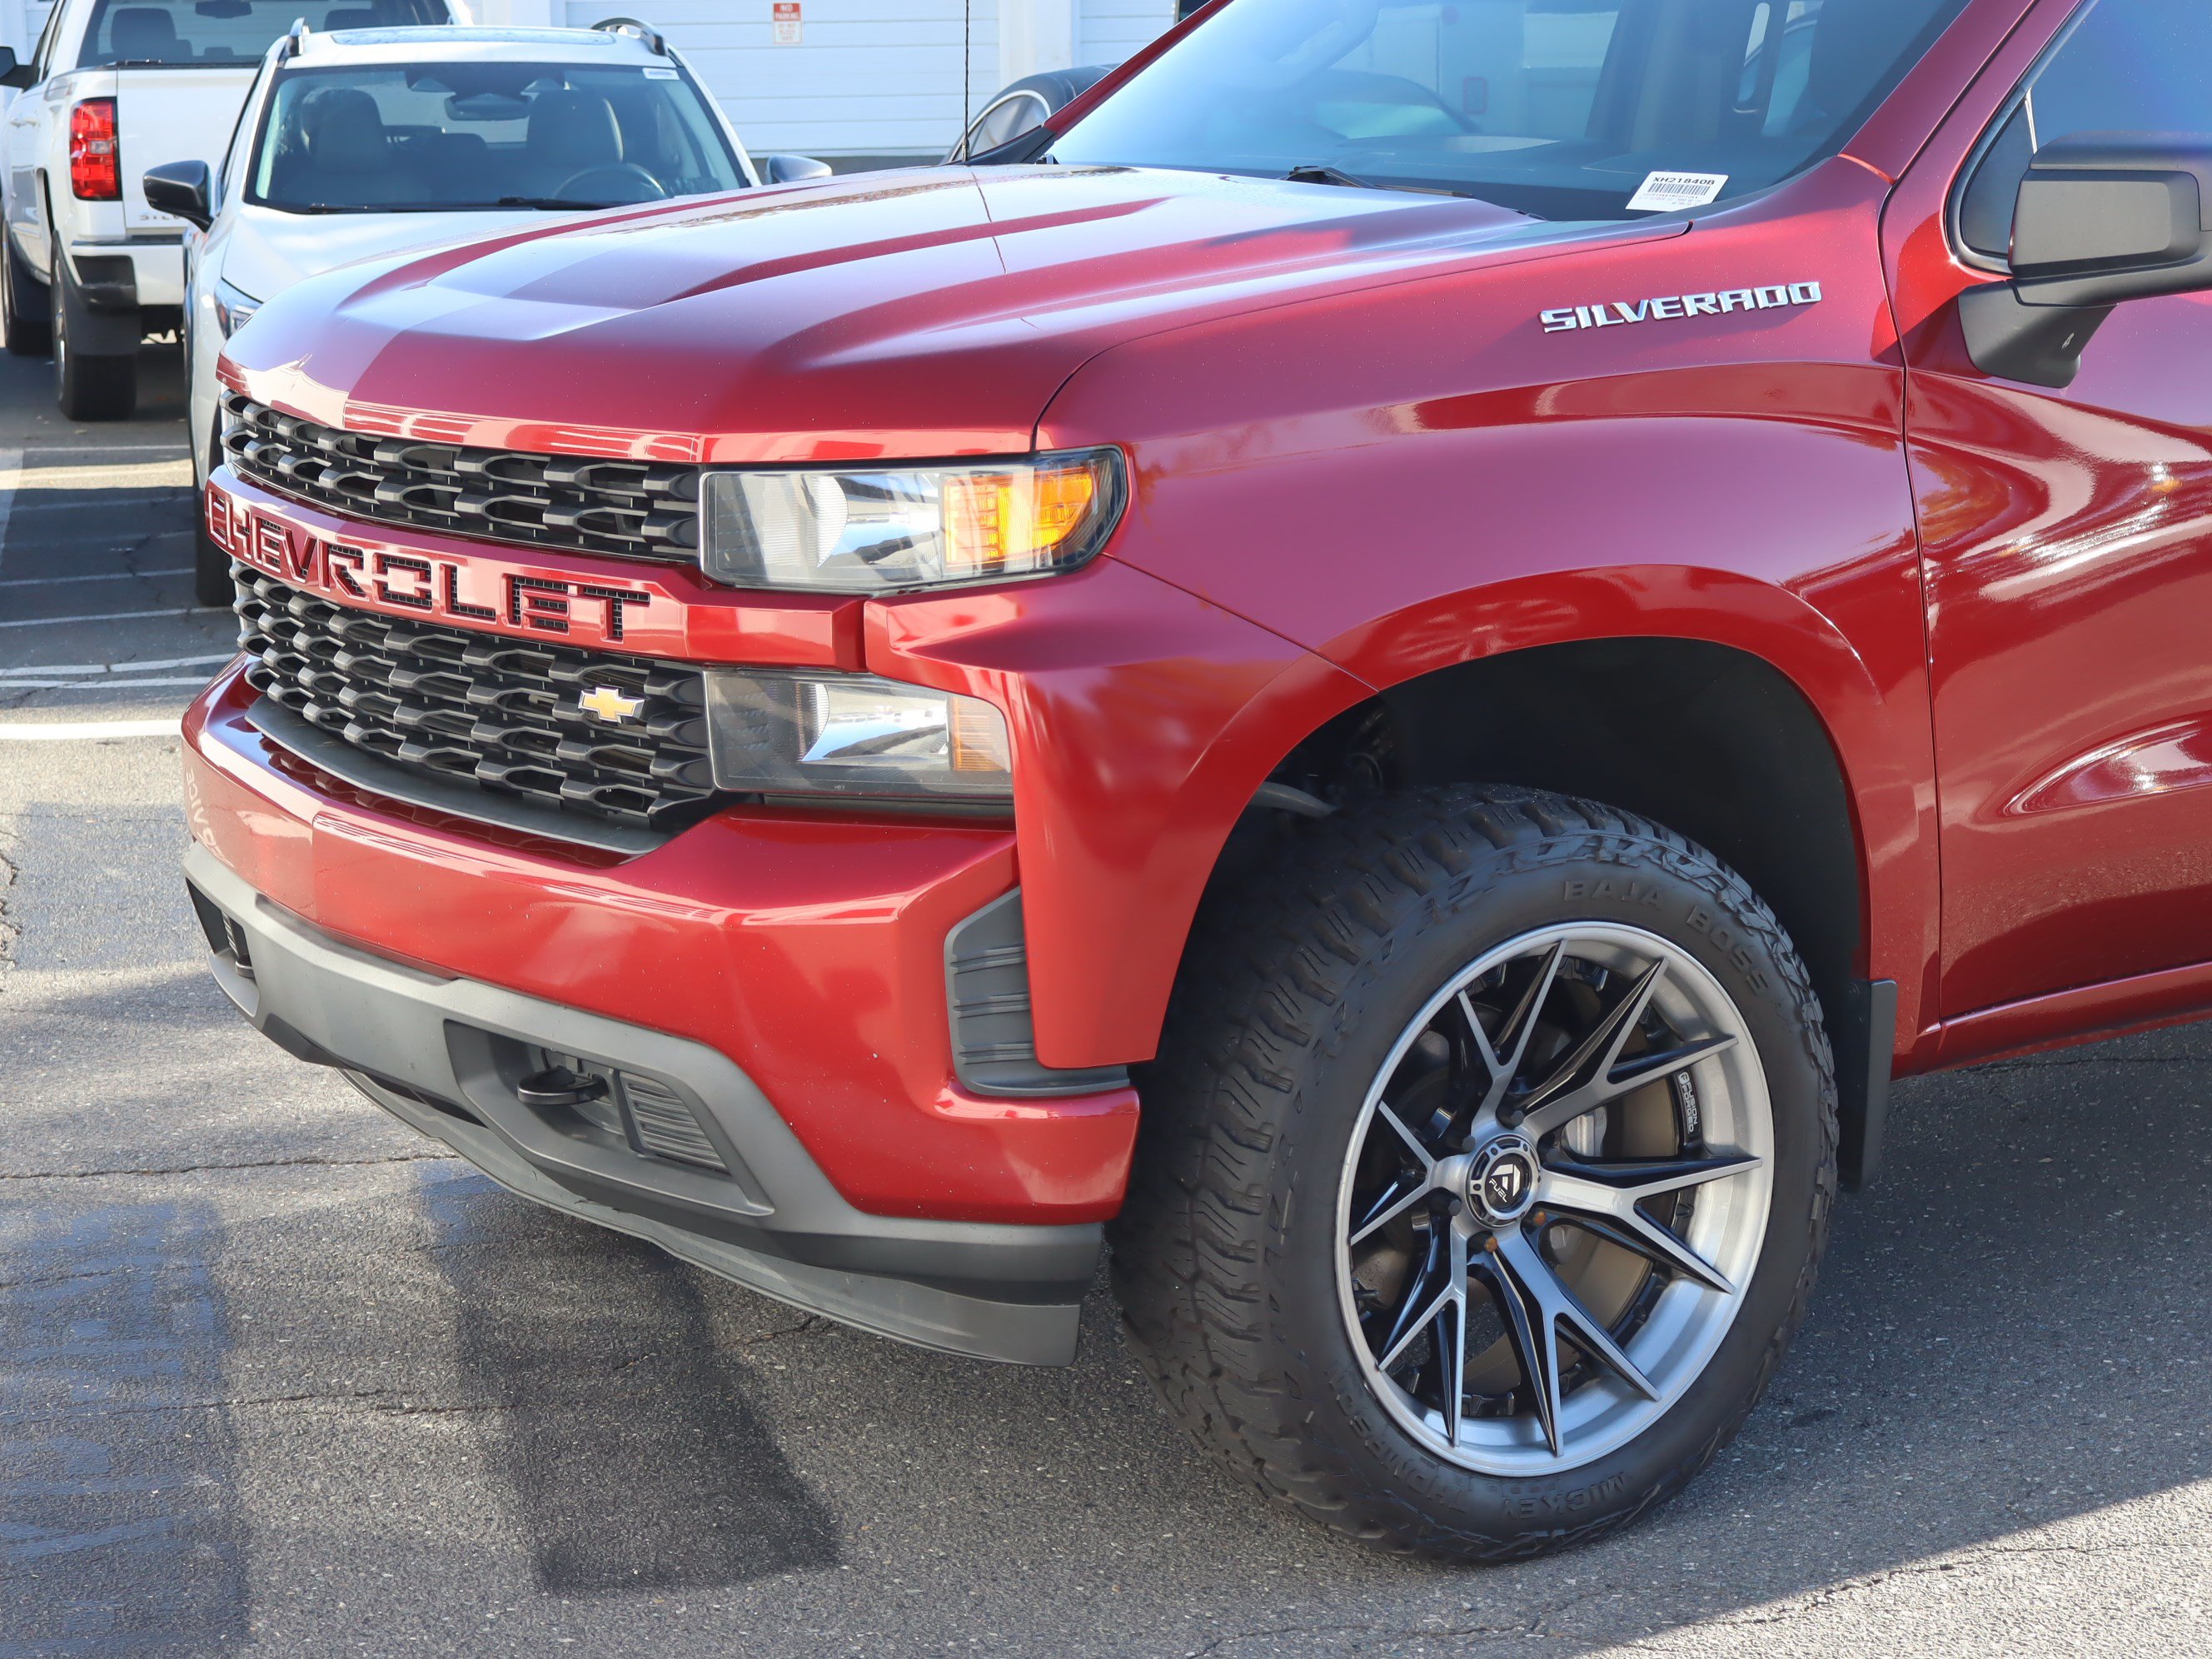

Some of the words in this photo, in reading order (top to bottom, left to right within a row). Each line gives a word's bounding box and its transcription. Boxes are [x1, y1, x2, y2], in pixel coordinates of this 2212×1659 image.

[1538, 281, 1821, 333] SILVERADO
[207, 491, 651, 643] CHEVROLET
[1563, 879, 1664, 910] BAJA
[1686, 905, 1769, 996] BOSS
[1681, 1084, 1694, 1133] FORGED
[1687, 1082, 1697, 1124] FUSION
[1489, 1178, 1507, 1203] FUEL
[1497, 1472, 1626, 1519] MICKEY
